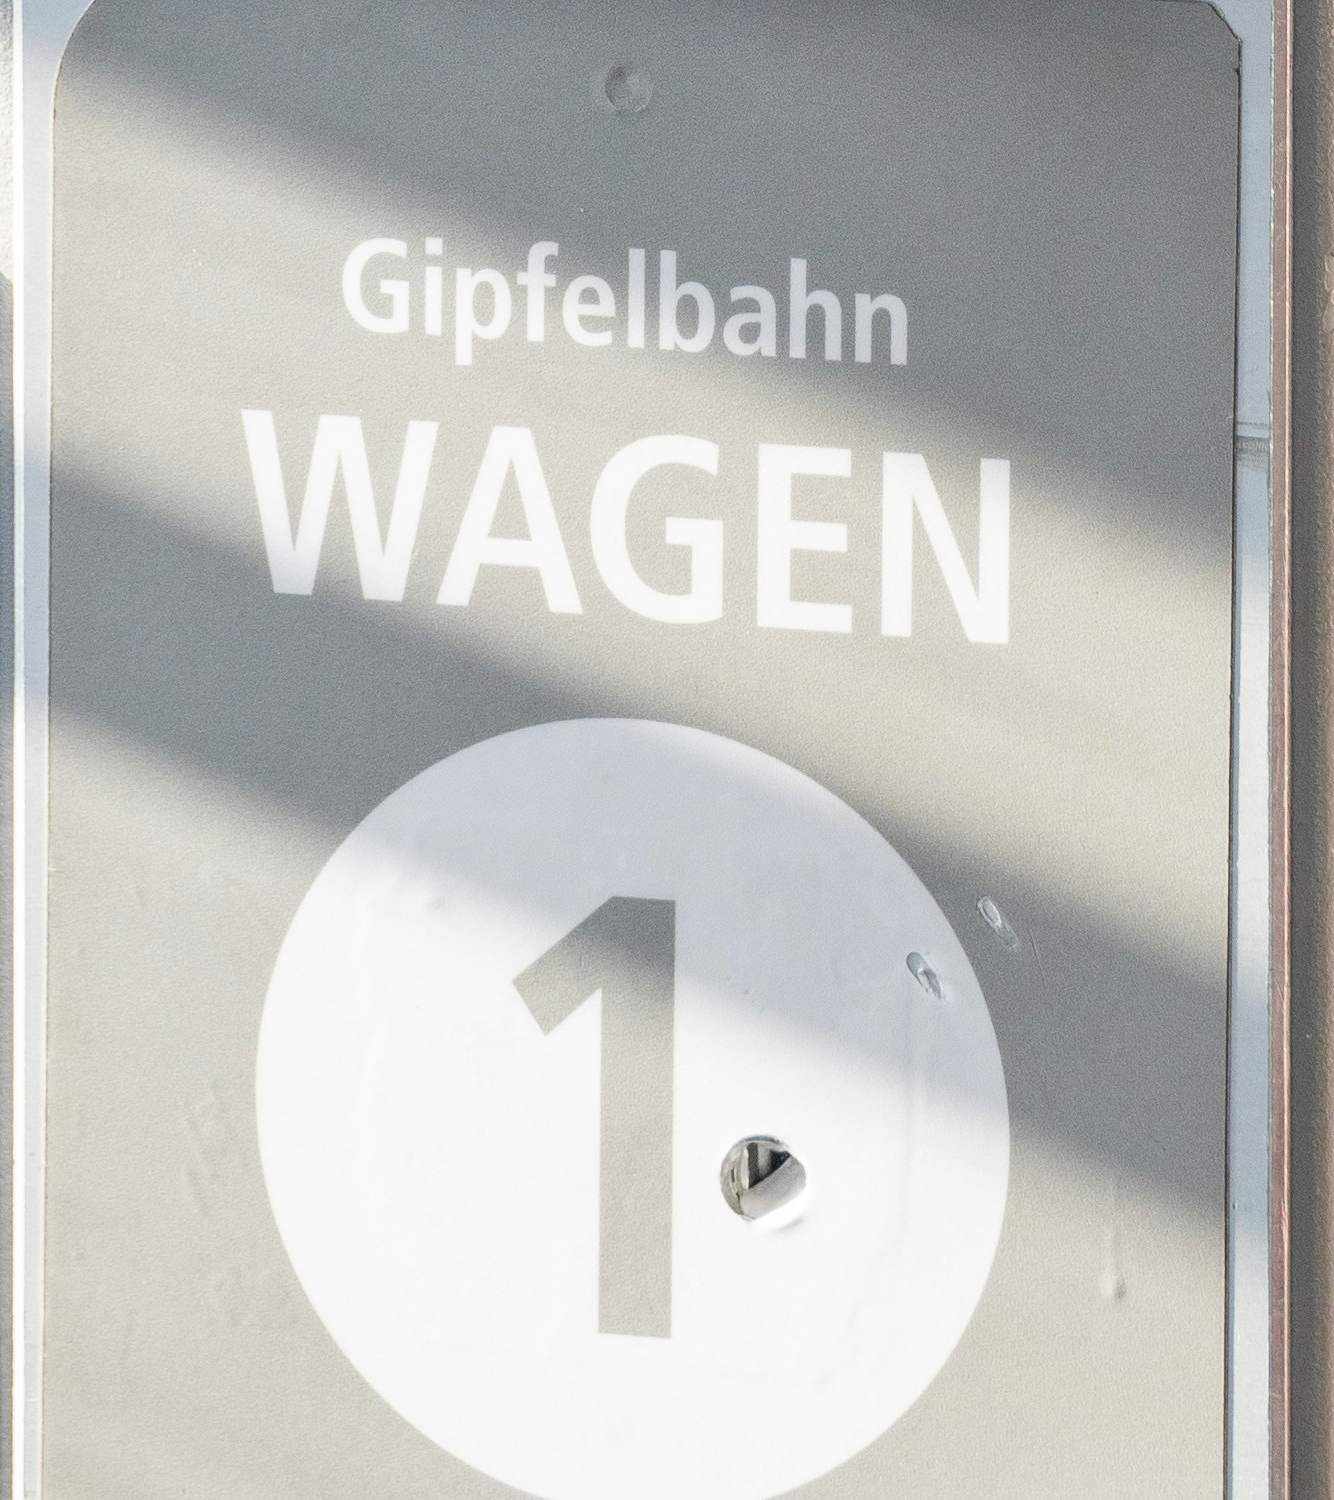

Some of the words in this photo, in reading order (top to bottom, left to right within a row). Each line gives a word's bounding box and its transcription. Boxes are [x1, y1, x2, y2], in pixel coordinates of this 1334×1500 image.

[339, 235, 911, 367] Gipfelbahn
[239, 408, 1011, 646] WAGEN
[510, 892, 679, 1340] 1
